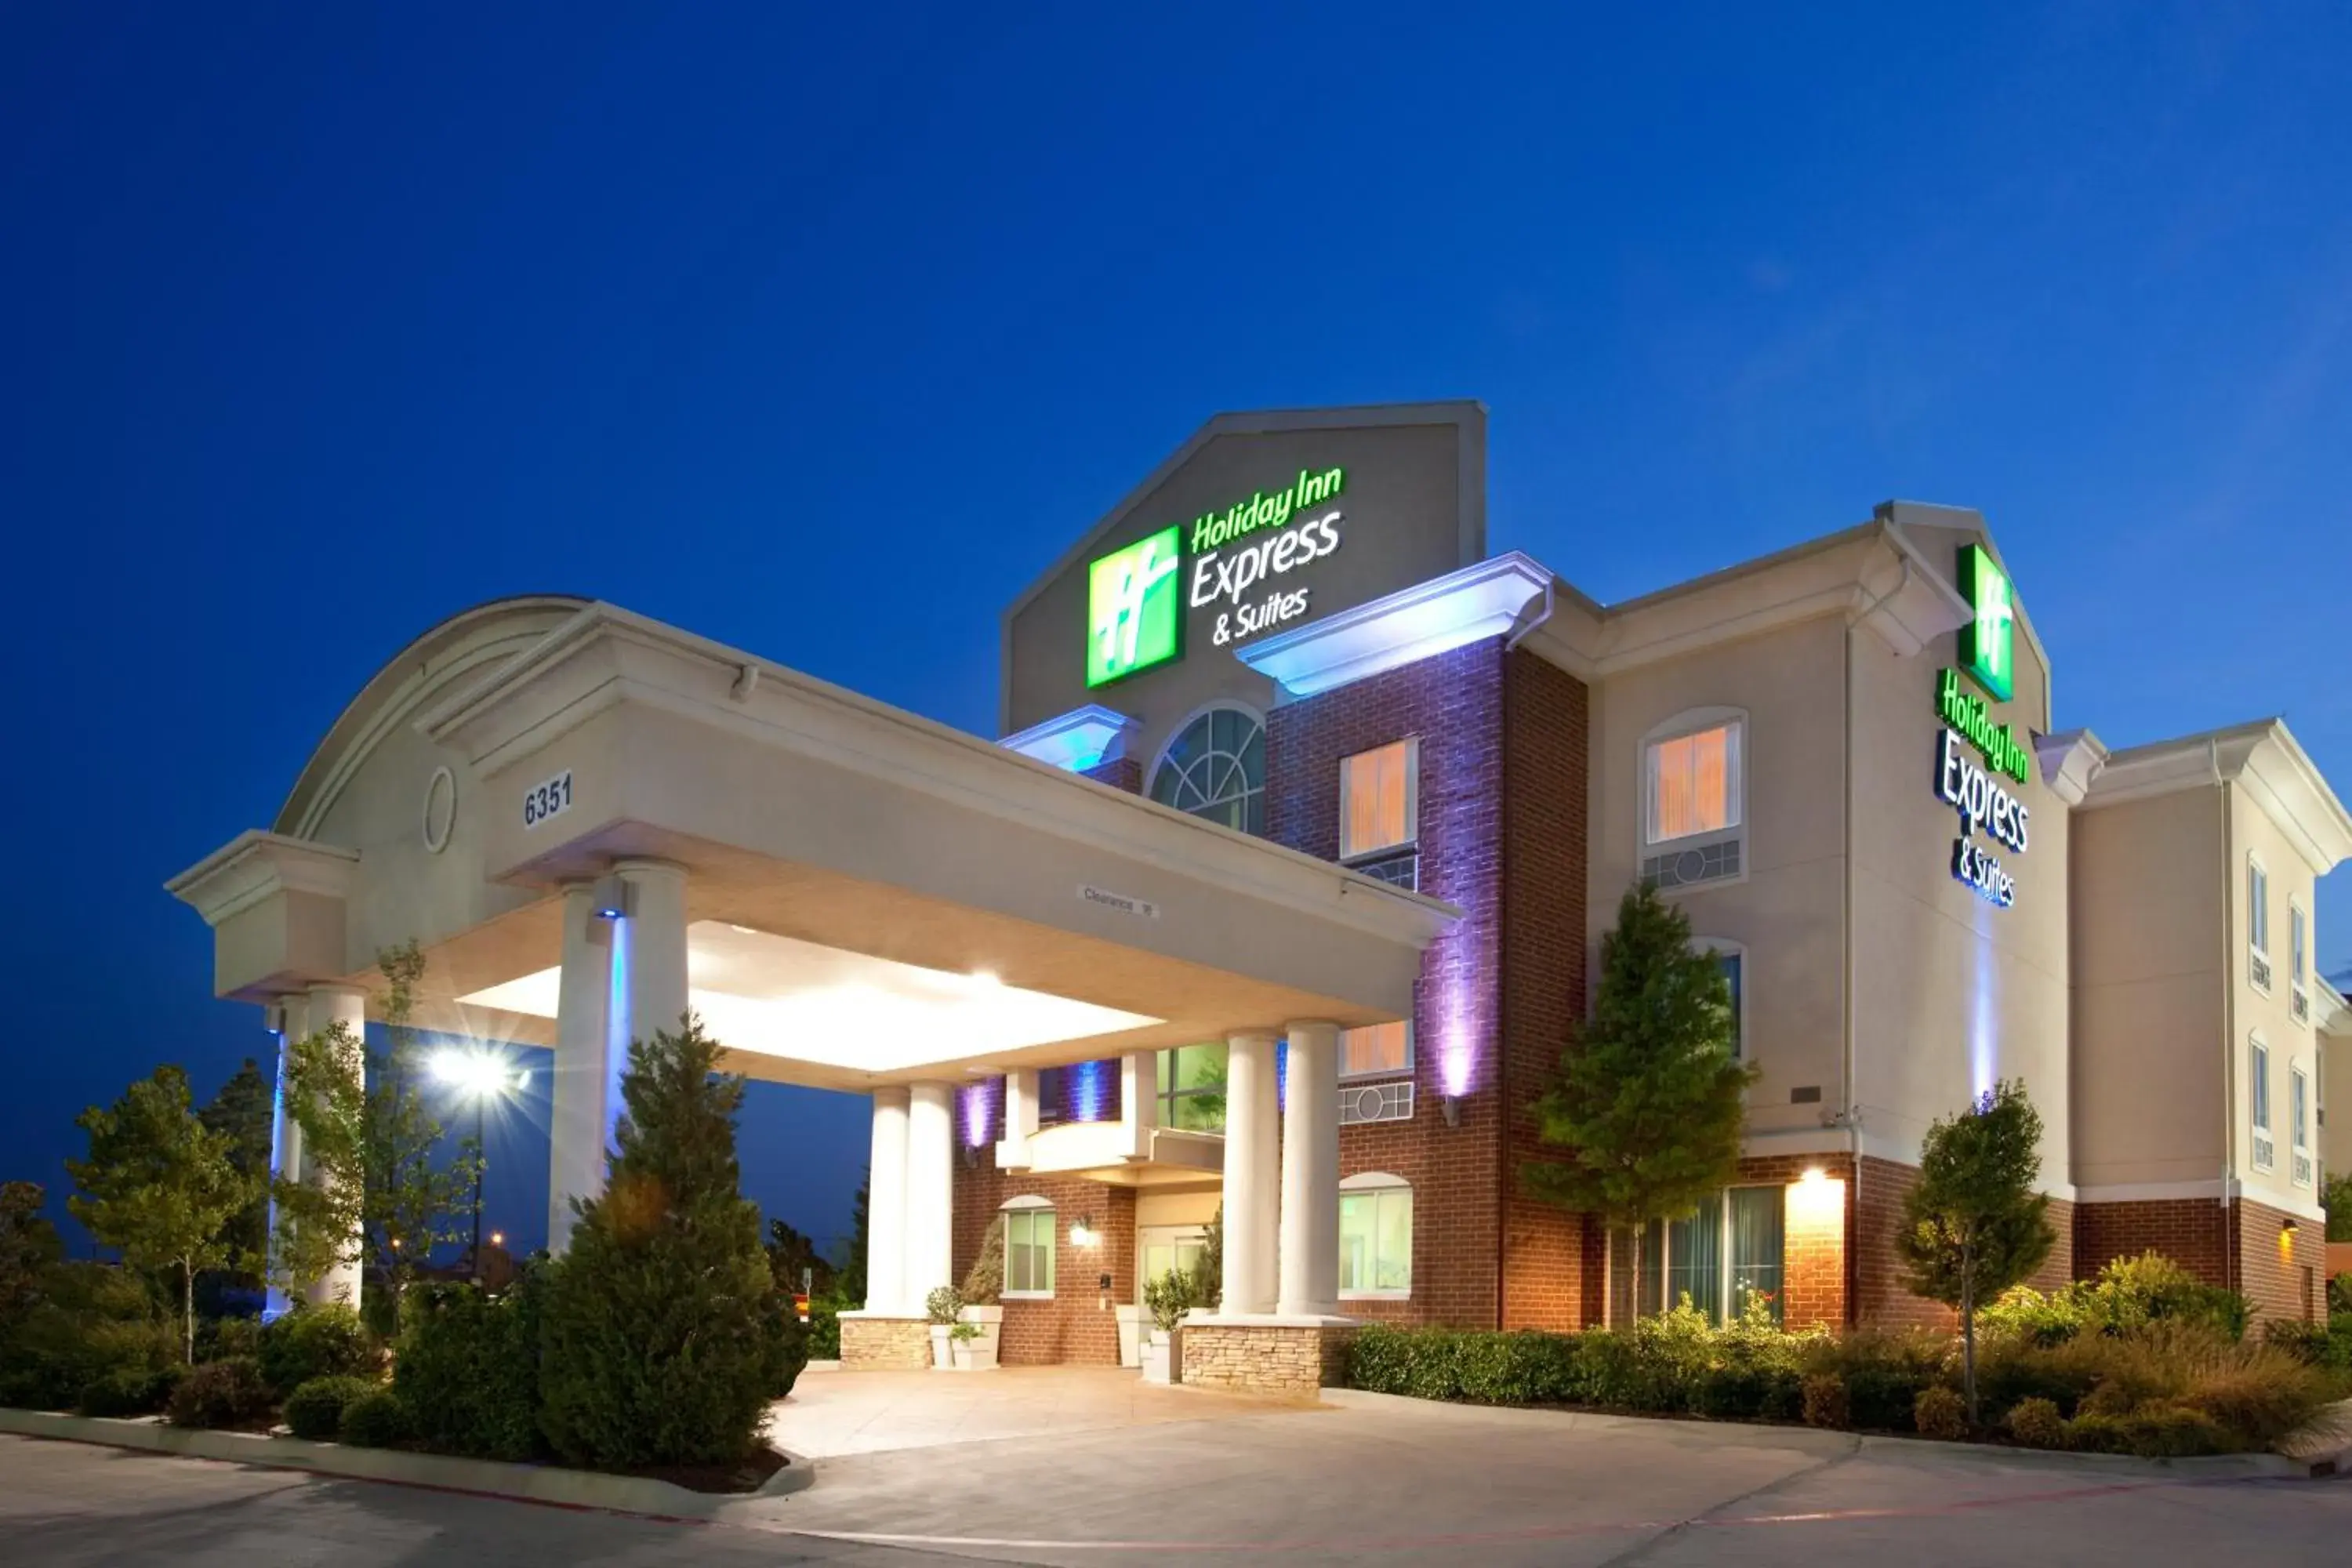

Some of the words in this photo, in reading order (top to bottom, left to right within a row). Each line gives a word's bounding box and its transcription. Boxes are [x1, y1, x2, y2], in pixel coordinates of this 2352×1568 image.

[1191, 488, 1294, 554] Holiday
[1295, 467, 1344, 510] Inn
[1190, 510, 1342, 608] Express
[1212, 614, 1230, 646] &
[1234, 587, 1309, 638] Suites
[1943, 669, 2004, 771] Holiday
[2003, 724, 2029, 783] Inn
[525, 772, 572, 825] 6351
[1943, 728, 2028, 854] Express
[1960, 837, 1973, 879] &
[1973, 847, 2015, 906] Suites
